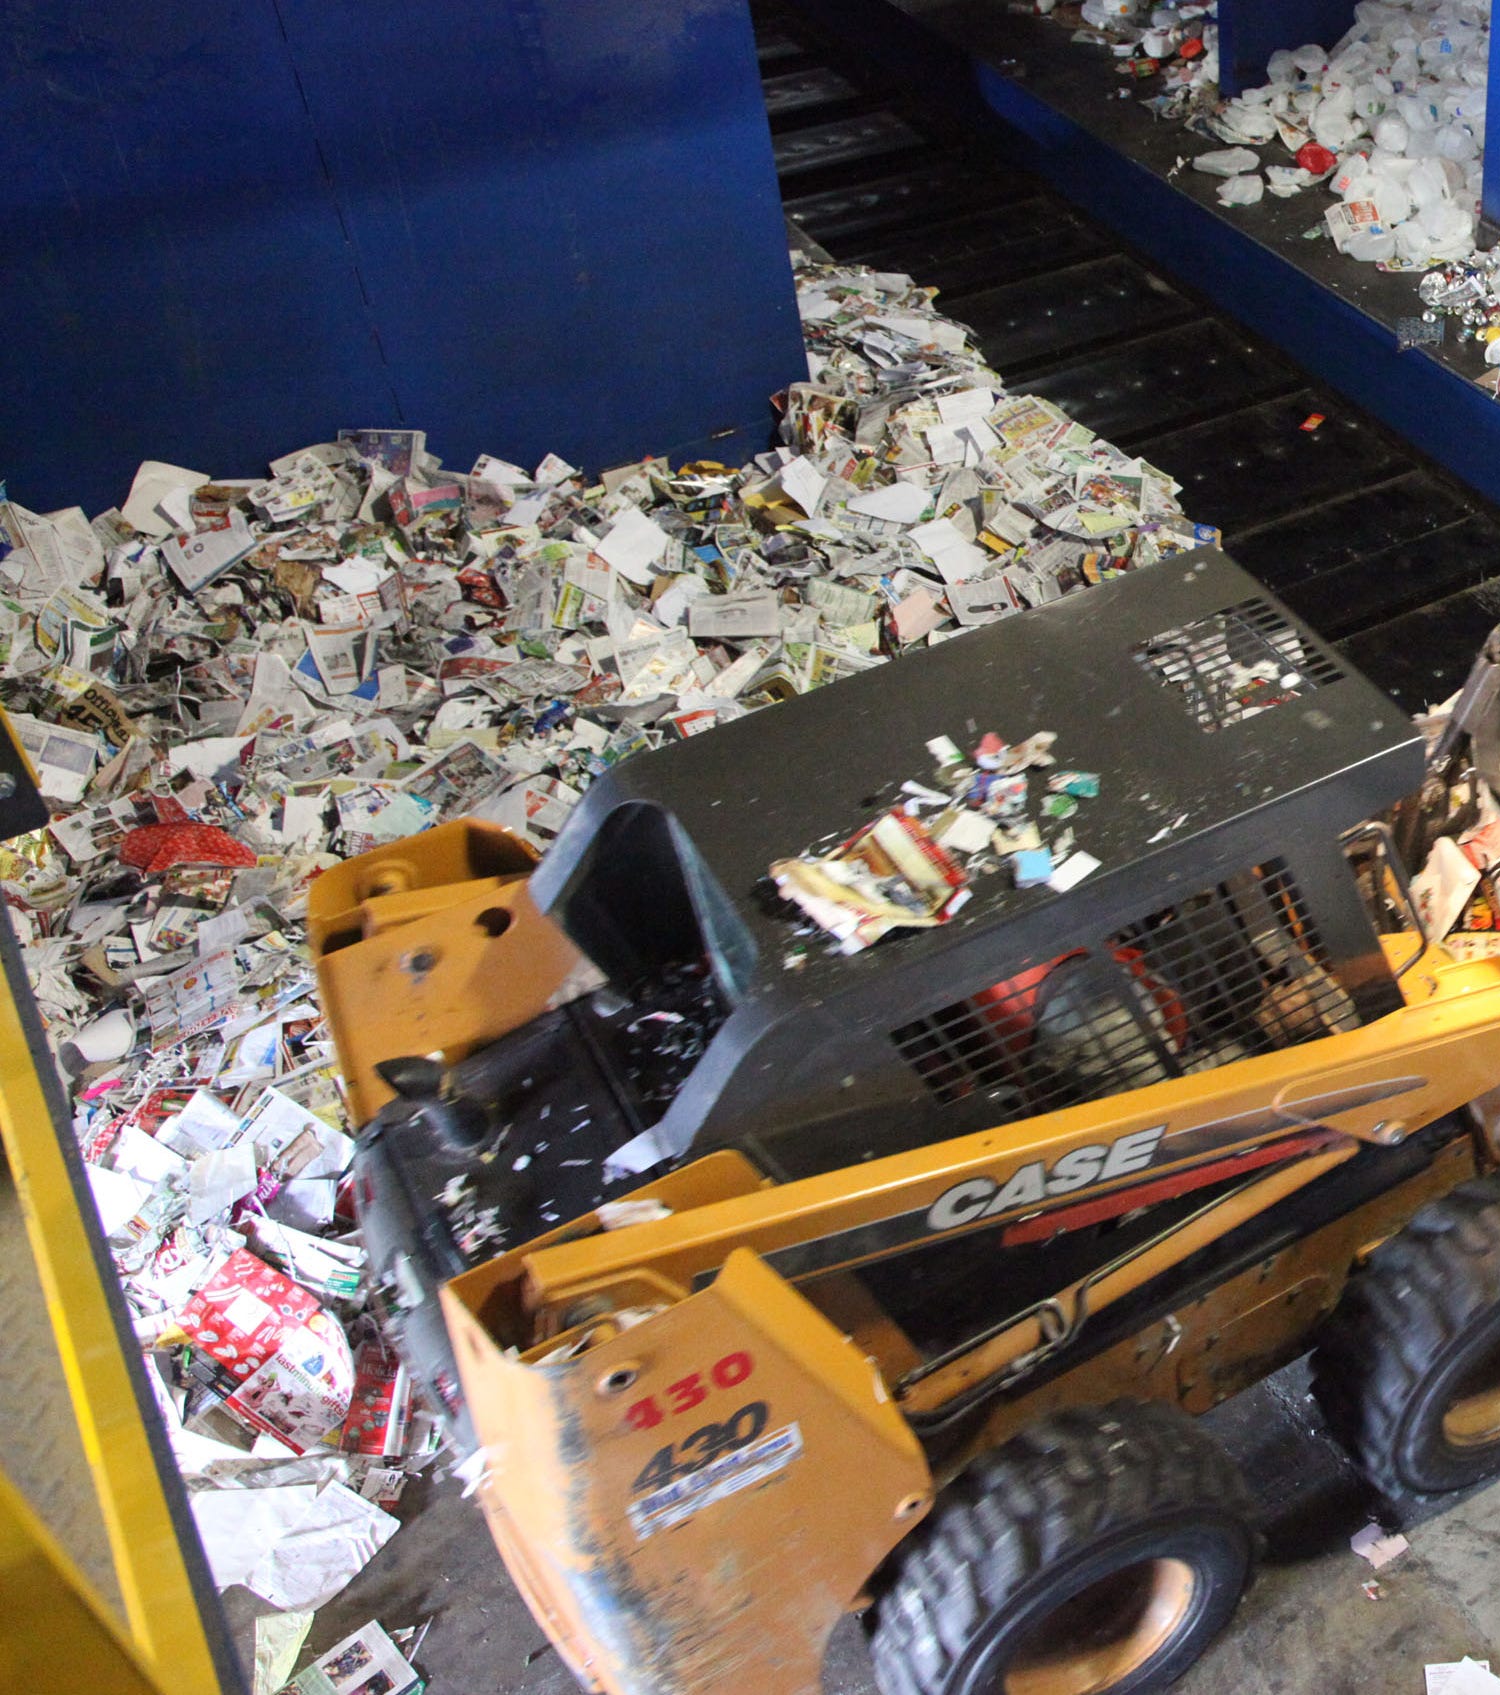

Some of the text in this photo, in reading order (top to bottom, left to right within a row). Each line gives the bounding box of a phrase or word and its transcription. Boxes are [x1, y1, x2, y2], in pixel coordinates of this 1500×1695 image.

[926, 1123, 1168, 1230] CASE
[625, 1351, 755, 1431] 430
[630, 1401, 770, 1491] 430
